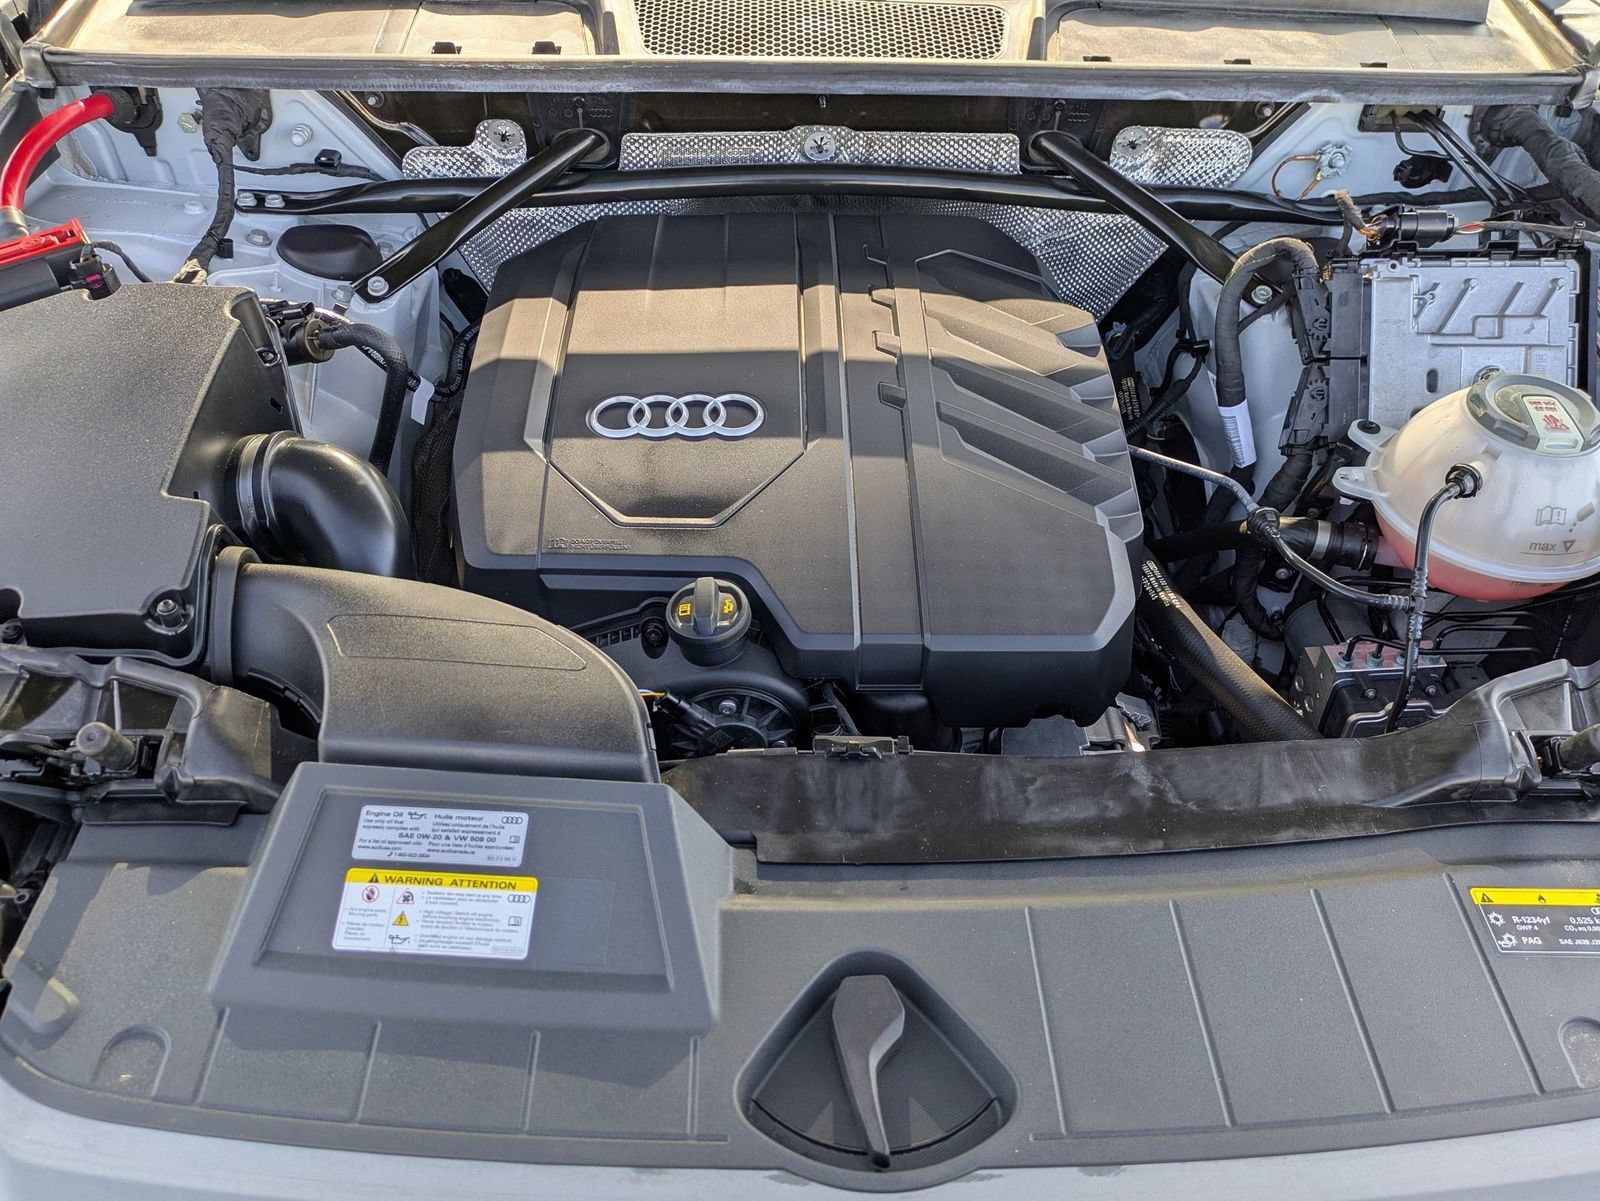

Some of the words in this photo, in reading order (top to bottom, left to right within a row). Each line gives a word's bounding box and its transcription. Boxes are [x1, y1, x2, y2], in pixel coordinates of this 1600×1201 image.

[1529, 542, 1557, 551] max
[365, 810, 391, 818] Engine
[384, 875, 444, 886] WARNING
[448, 878, 518, 890] ATTENTION
[1569, 917, 1593, 925] 0,525
